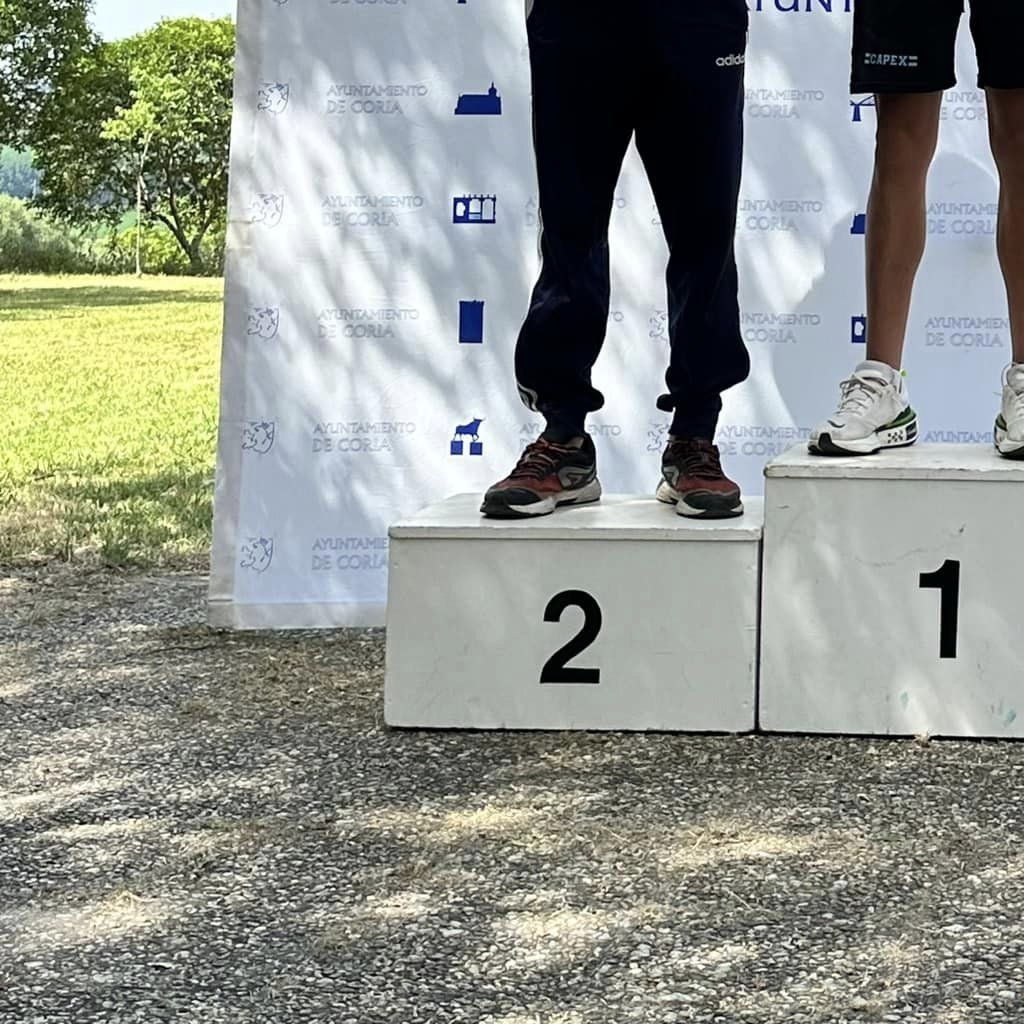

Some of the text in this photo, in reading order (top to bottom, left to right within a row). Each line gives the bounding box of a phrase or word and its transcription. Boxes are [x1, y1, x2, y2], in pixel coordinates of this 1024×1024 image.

[326, 84, 428, 96] AYUNTAMIENTO
[326, 100, 404, 115] DE CORIA
[748, 104, 800, 119] CORIA
[745, 216, 799, 232] CORIA
[924, 316, 1008, 330] AYUNTAMIEN
[744, 328, 798, 344] CORIA
[924, 332, 1004, 348] DE CORIA
[312, 538, 388, 551] AYUNTAMIE
[312, 555, 332, 570] DE
[918, 559, 962, 660] 1
[540, 589, 602, 684] 2
